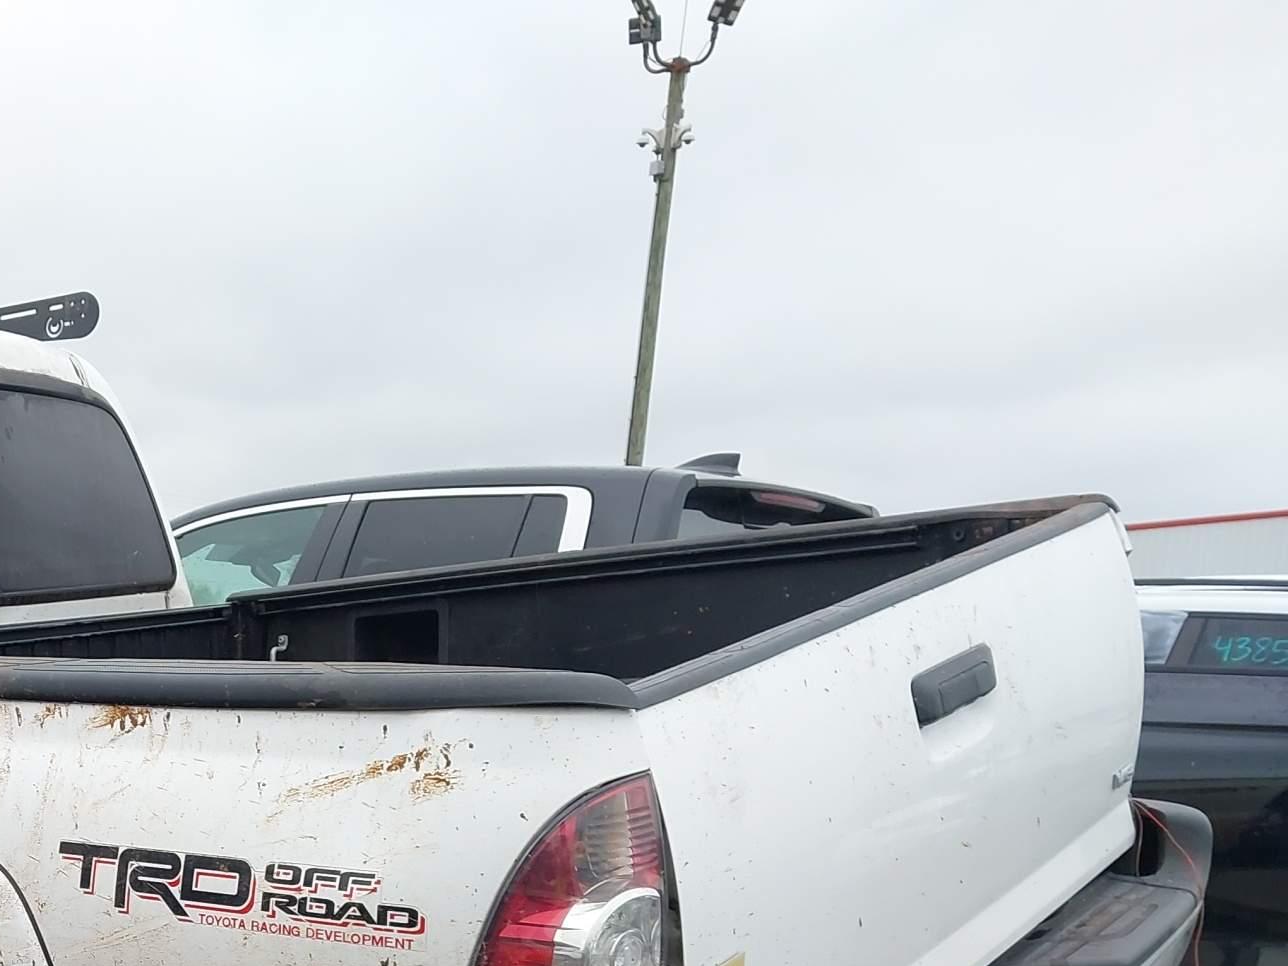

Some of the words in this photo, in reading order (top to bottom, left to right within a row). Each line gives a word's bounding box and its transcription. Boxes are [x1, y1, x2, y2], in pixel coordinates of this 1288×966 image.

[59, 840, 255, 922] TRD
[263, 863, 380, 898] OFF
[198, 913, 246, 929] TOYOTA
[251, 920, 301, 938] RACING
[306, 928, 415, 950] DEVELOPMENT
[261, 891, 425, 934] ROAD
